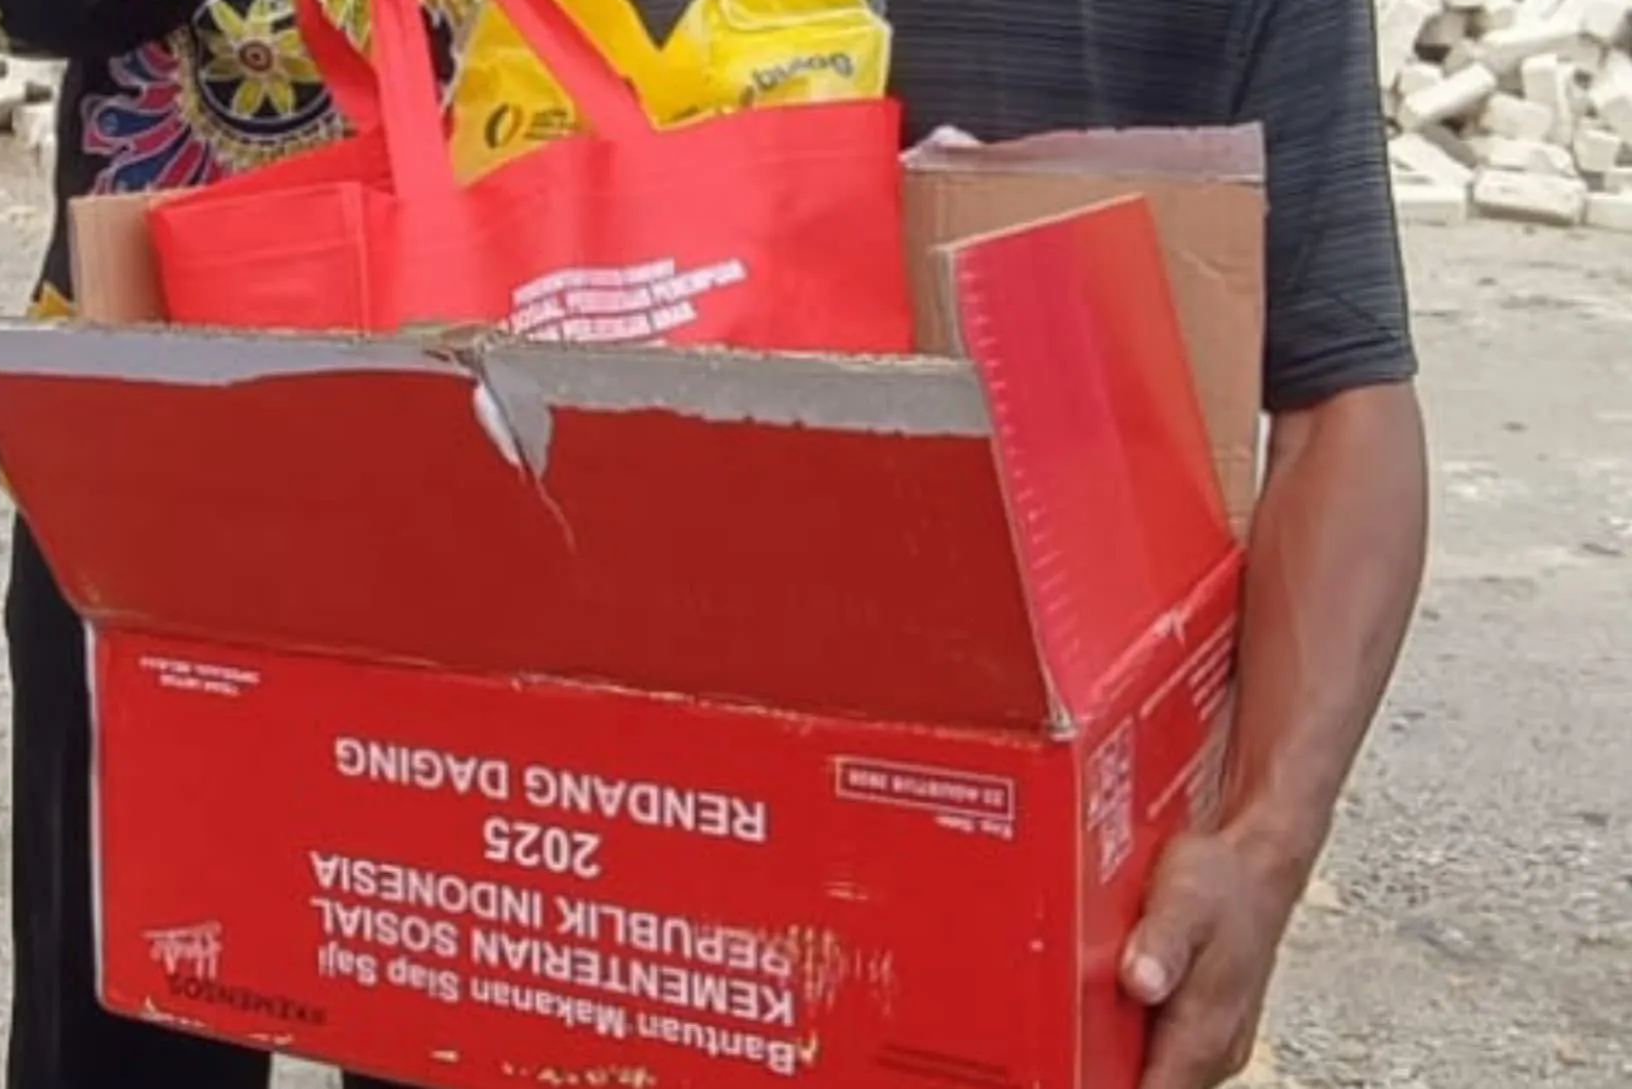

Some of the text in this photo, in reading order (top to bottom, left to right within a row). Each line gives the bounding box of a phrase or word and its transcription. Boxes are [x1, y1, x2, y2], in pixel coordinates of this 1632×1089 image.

[334, 735, 768, 843] RENDANG DAGING
[483, 816, 602, 878] 2025
[309, 850, 794, 977] REPUBLIK INDONESIA
[310, 897, 794, 1026] KEMENTERIAN SOSIAL
[317, 939, 796, 1075] Bantuan Makanan Siap Saji
